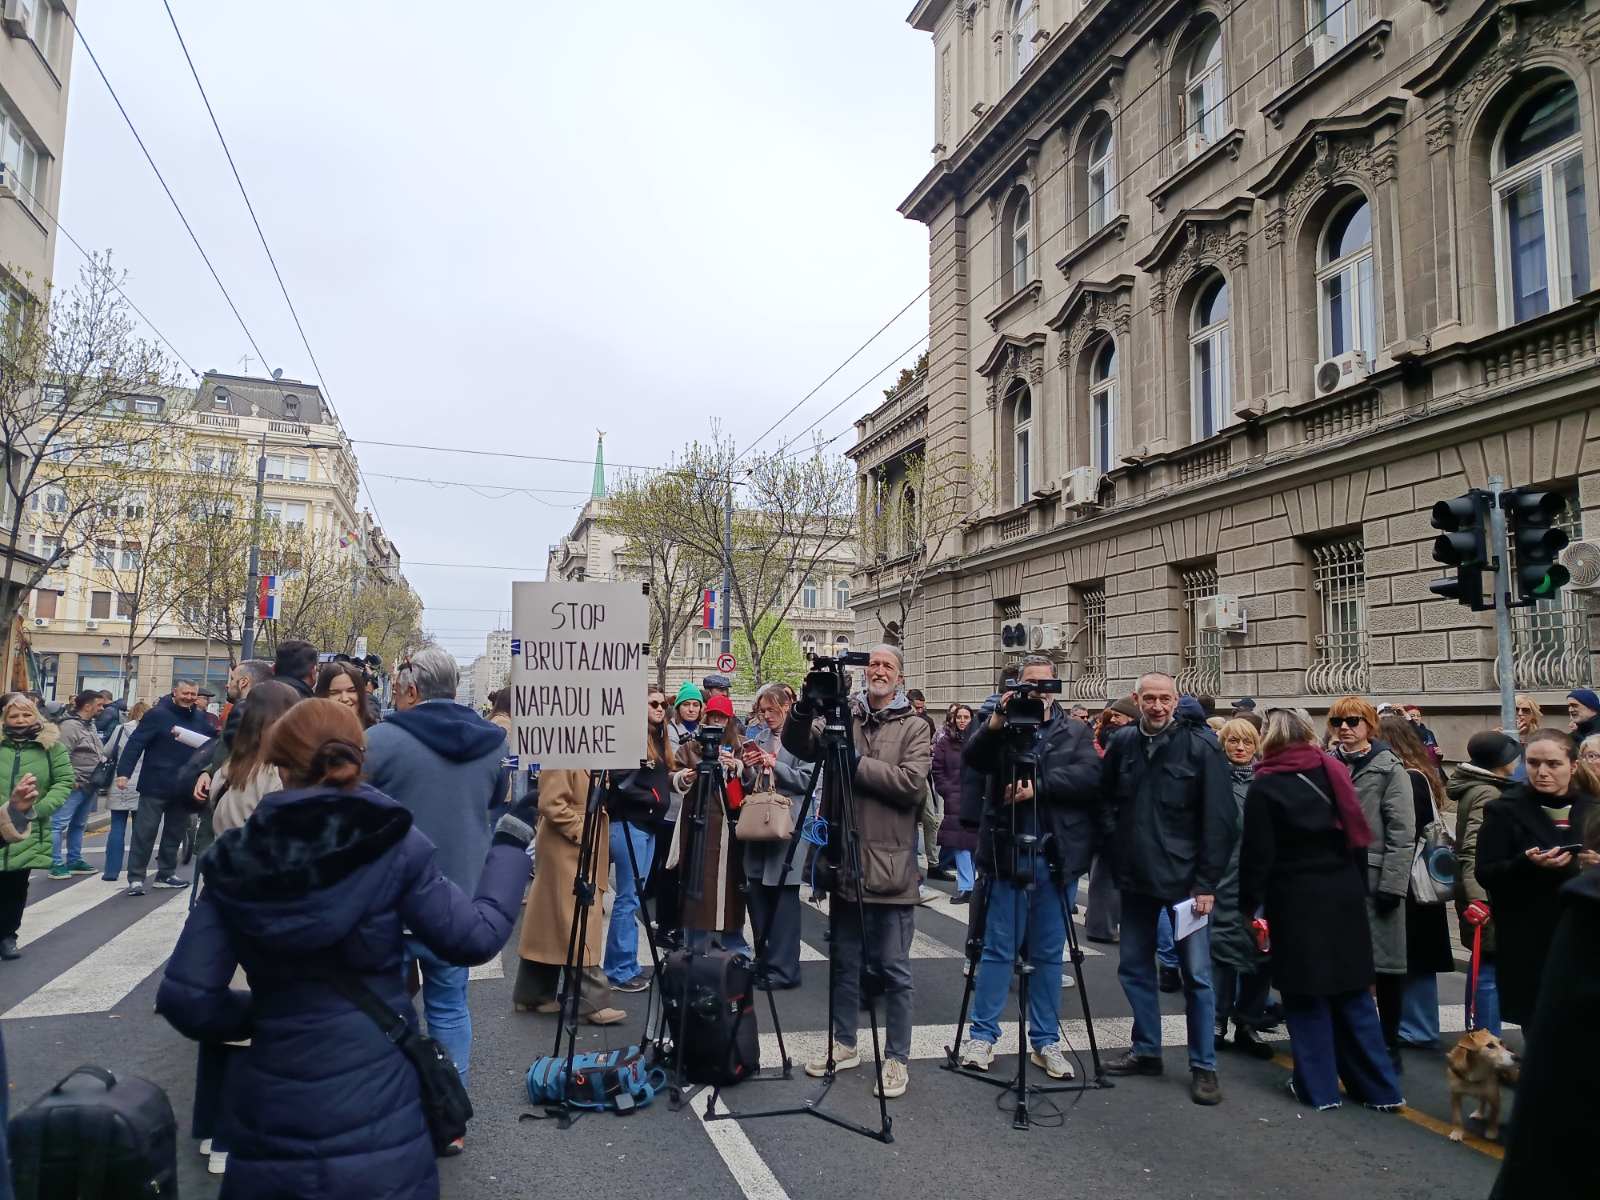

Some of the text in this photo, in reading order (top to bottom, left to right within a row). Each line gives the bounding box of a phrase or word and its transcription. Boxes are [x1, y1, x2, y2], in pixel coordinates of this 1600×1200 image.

[551, 602, 605, 630] STOP
[524, 641, 640, 670] BRUTALNOM
[515, 685, 625, 716] NAPADU NA
[517, 725, 617, 755] NOVINARE
